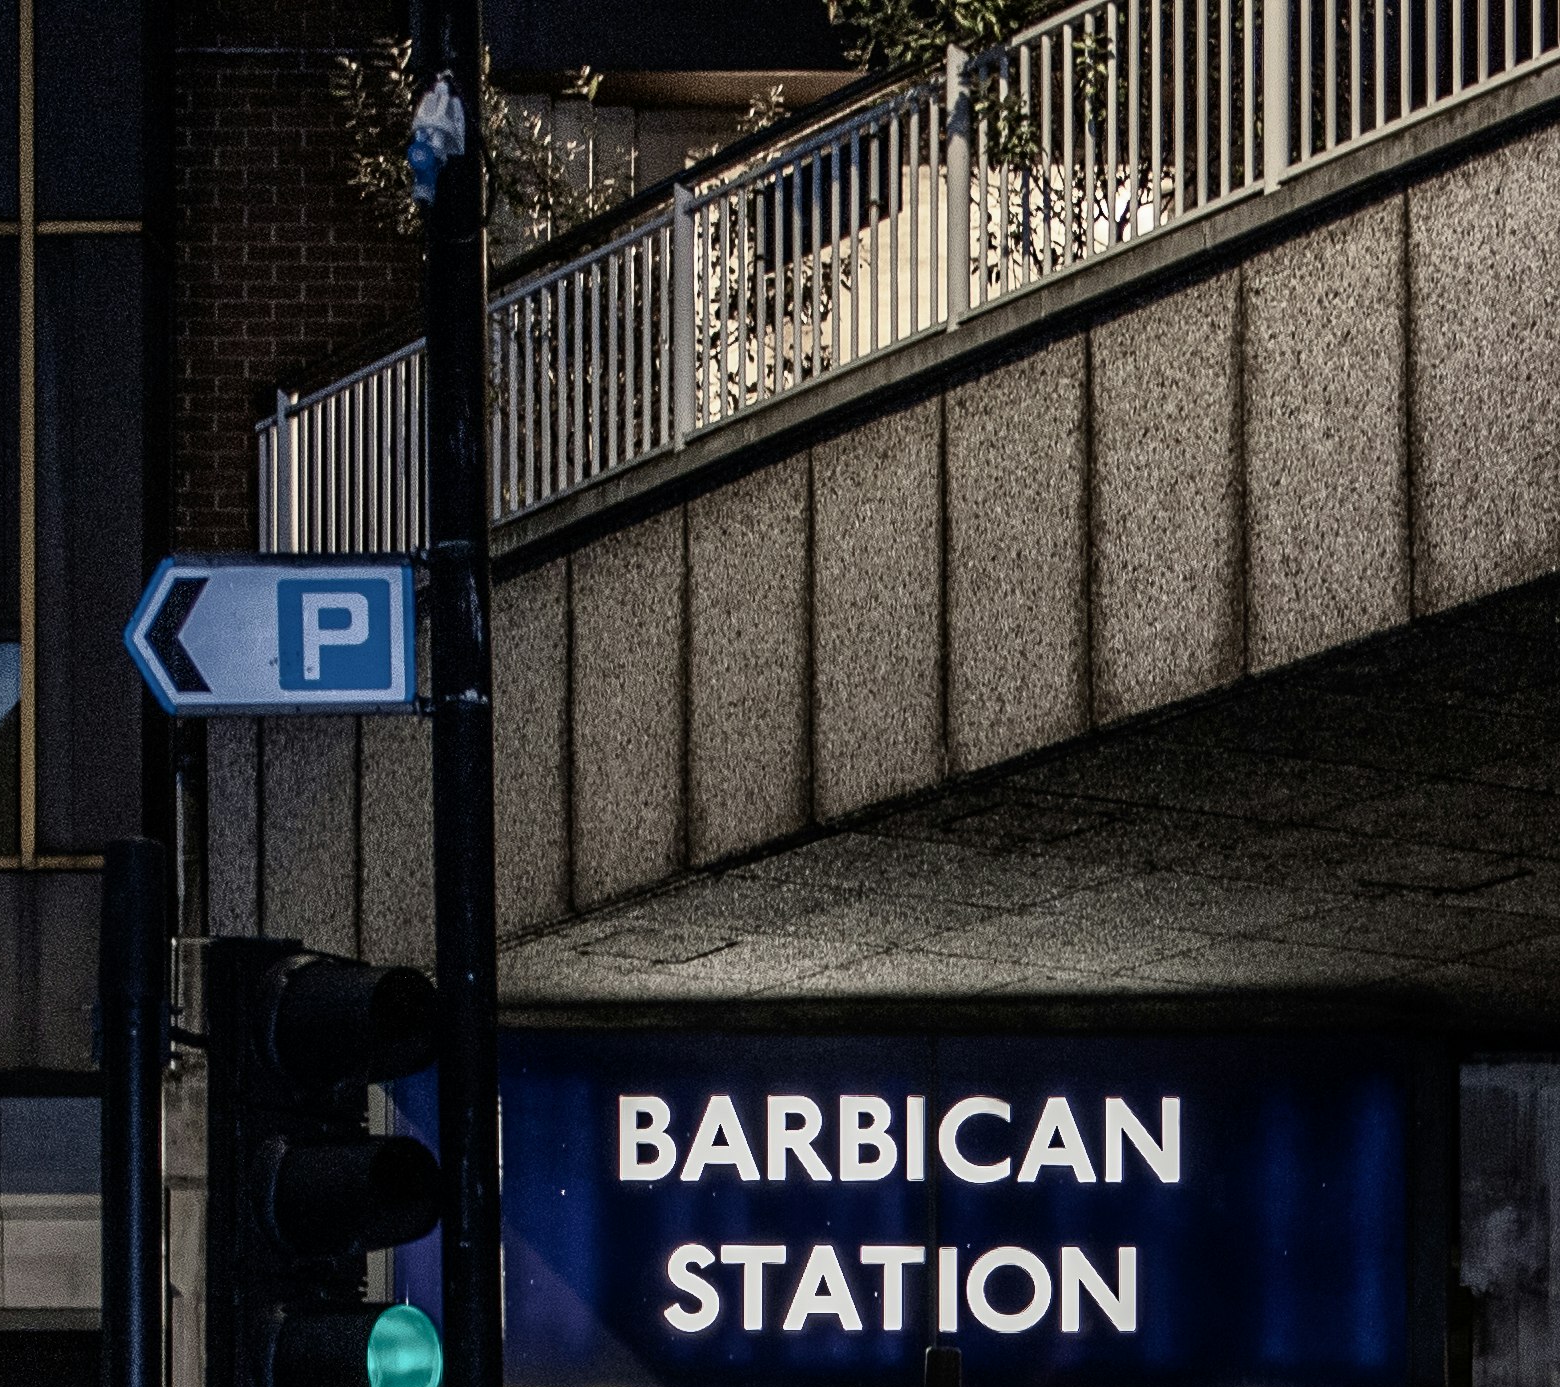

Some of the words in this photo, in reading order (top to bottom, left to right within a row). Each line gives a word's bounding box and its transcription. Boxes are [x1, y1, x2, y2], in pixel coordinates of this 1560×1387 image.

[302, 592, 369, 681] P
[618, 1094, 1181, 1185] BARBICAN
[663, 1243, 1137, 1334] STATION
